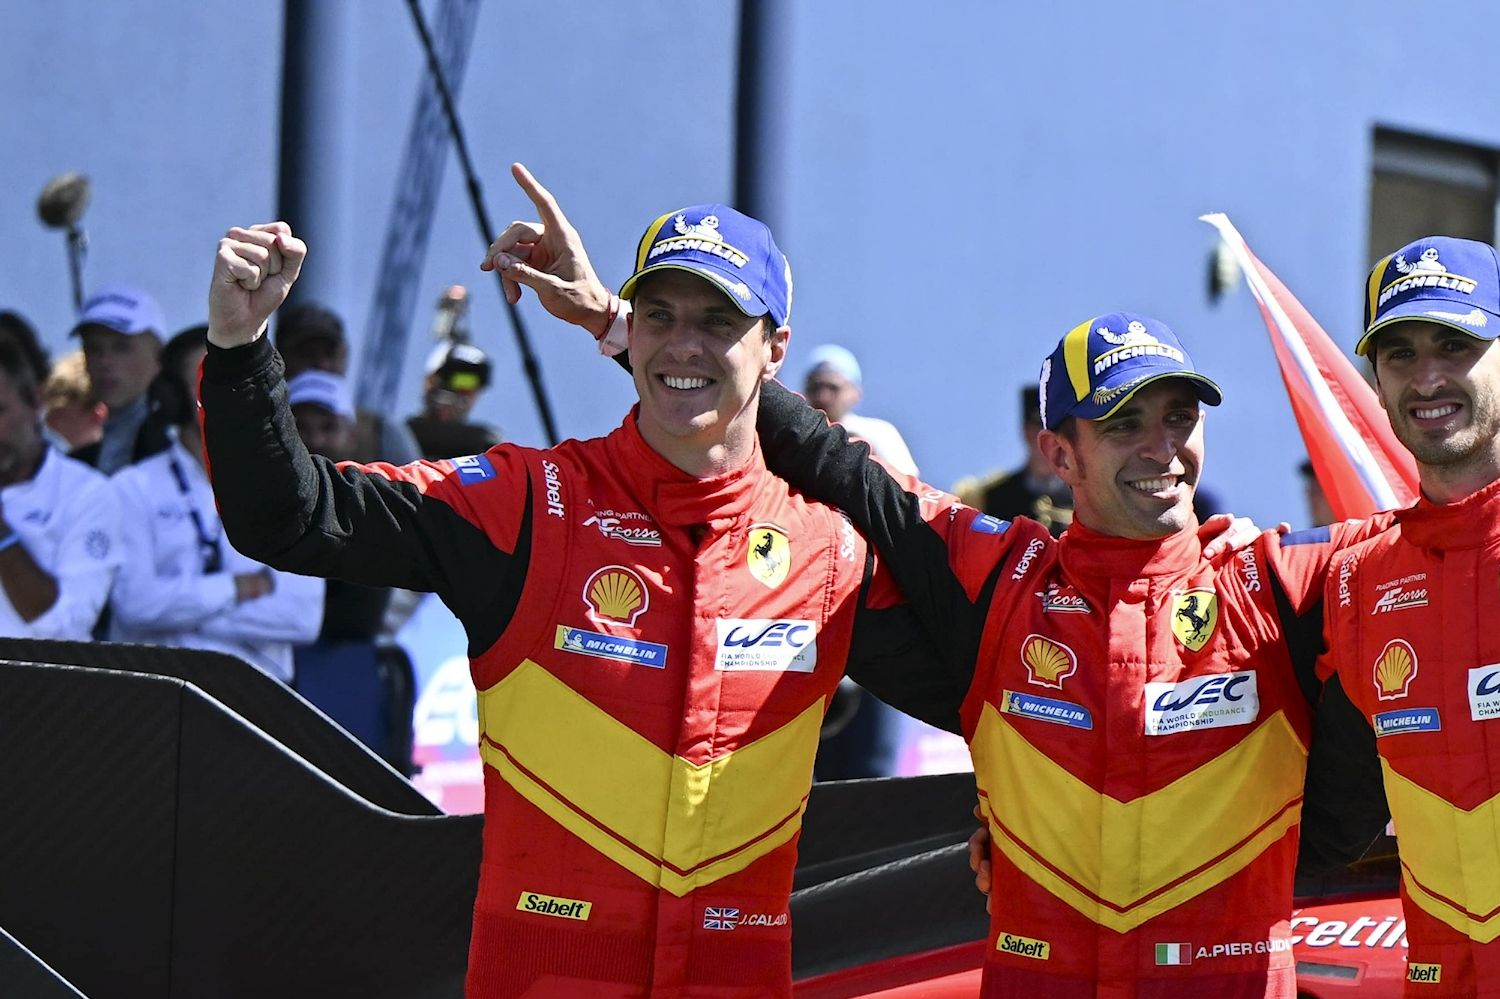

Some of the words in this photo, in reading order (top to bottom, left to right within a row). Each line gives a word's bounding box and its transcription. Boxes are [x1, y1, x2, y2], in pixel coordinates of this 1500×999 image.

[649, 239, 748, 269] MICHELIN
[1379, 276, 1475, 307] MICHELIN
[1094, 345, 1185, 376] MICHELIN
[541, 459, 565, 519] Sabelt
[1399, 573, 1427, 585] PARTNER
[723, 622, 809, 648] WEC
[585, 639, 657, 661] MICHELIN
[721, 660, 778, 668] CHAMPIONSHIP
[1152, 675, 1250, 712] WEC
[1022, 702, 1085, 721] MICHELIN
[1166, 712, 1195, 723] WORLD
[1196, 707, 1246, 719] ENDURANCE
[1477, 702, 1491, 710] FIA
[1152, 718, 1215, 732] CHAMPIONSHIP
[1382, 715, 1431, 729] MICHELIN
[525, 894, 586, 918] Sabelt
[1001, 934, 1047, 957] Sabelt
